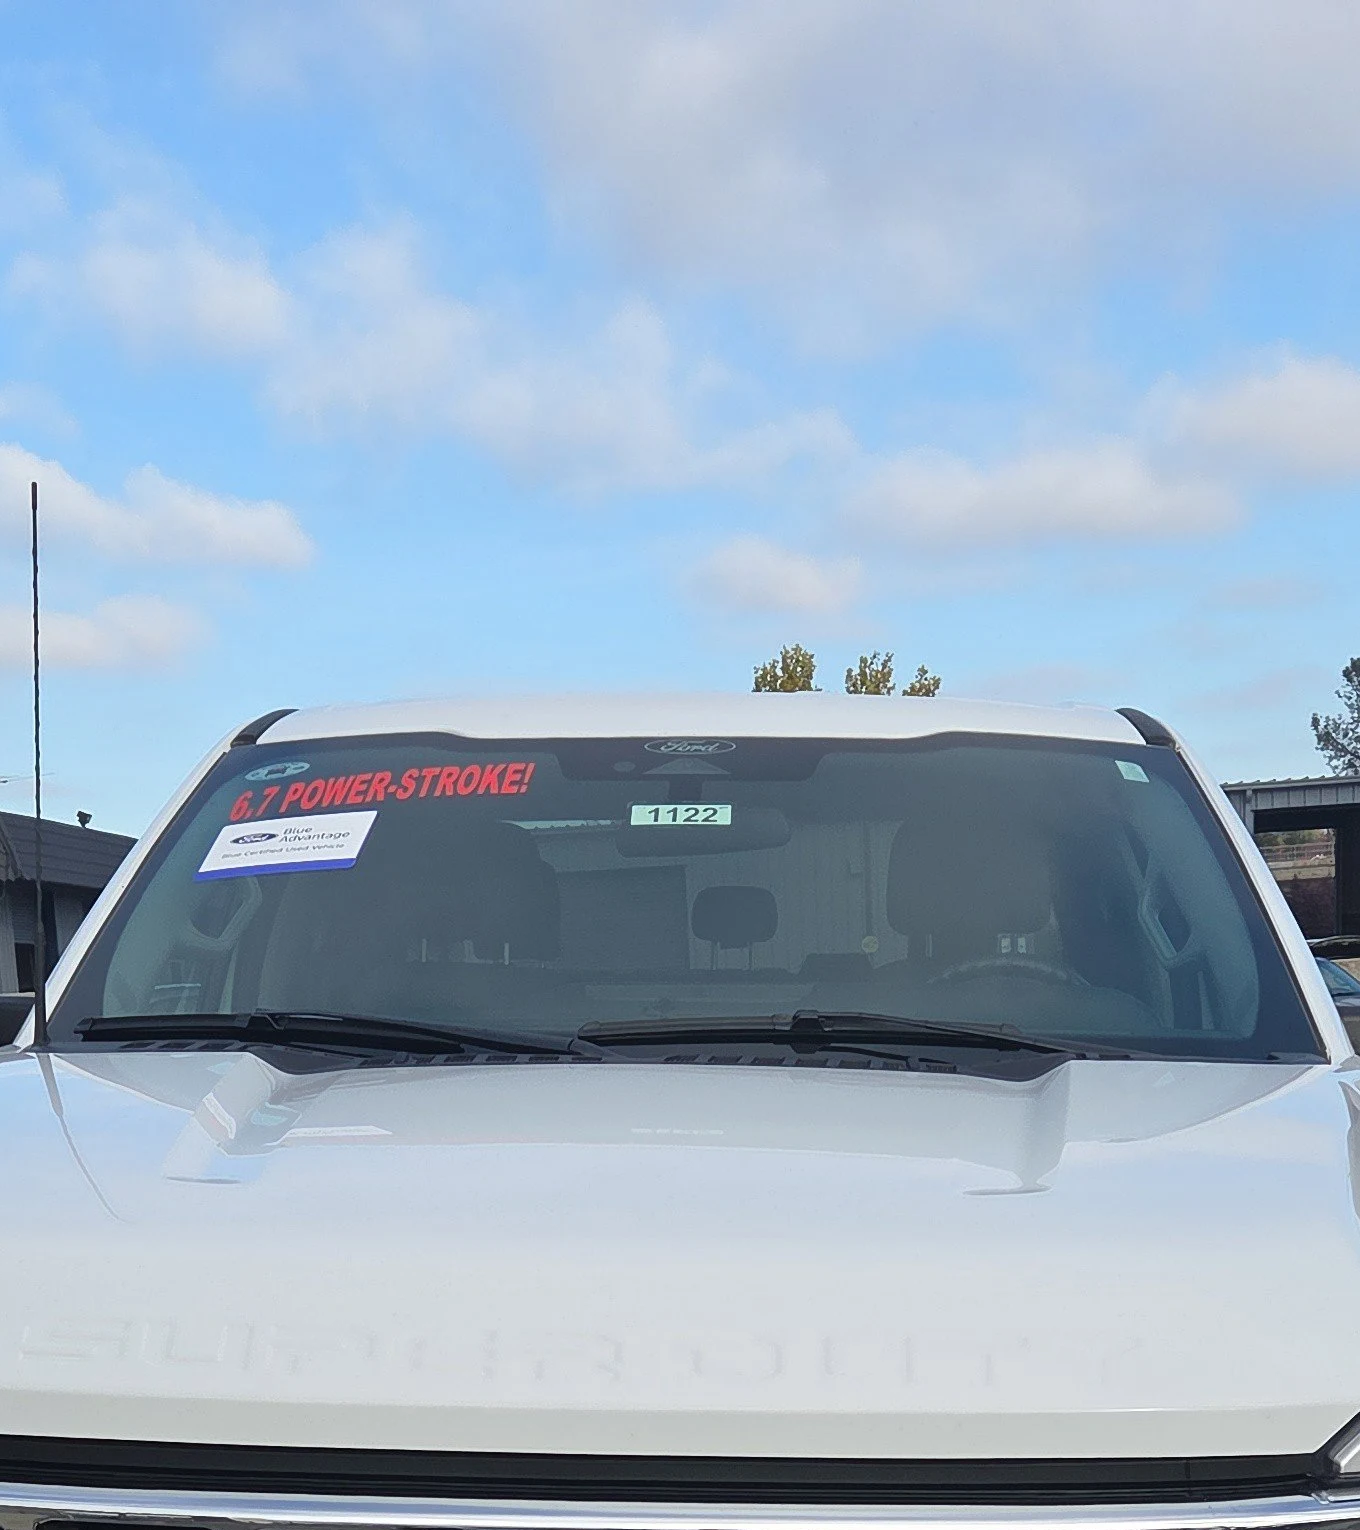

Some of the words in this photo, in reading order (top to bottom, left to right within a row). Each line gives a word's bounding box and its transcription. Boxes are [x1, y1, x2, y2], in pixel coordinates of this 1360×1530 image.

[660, 739, 720, 752] Ford
[228, 785, 280, 822] 6.7
[279, 762, 536, 814] POWER-STROKE!
[647, 806, 719, 823] 1122
[280, 831, 351, 843] Advantage
[283, 827, 313, 835] Blue
